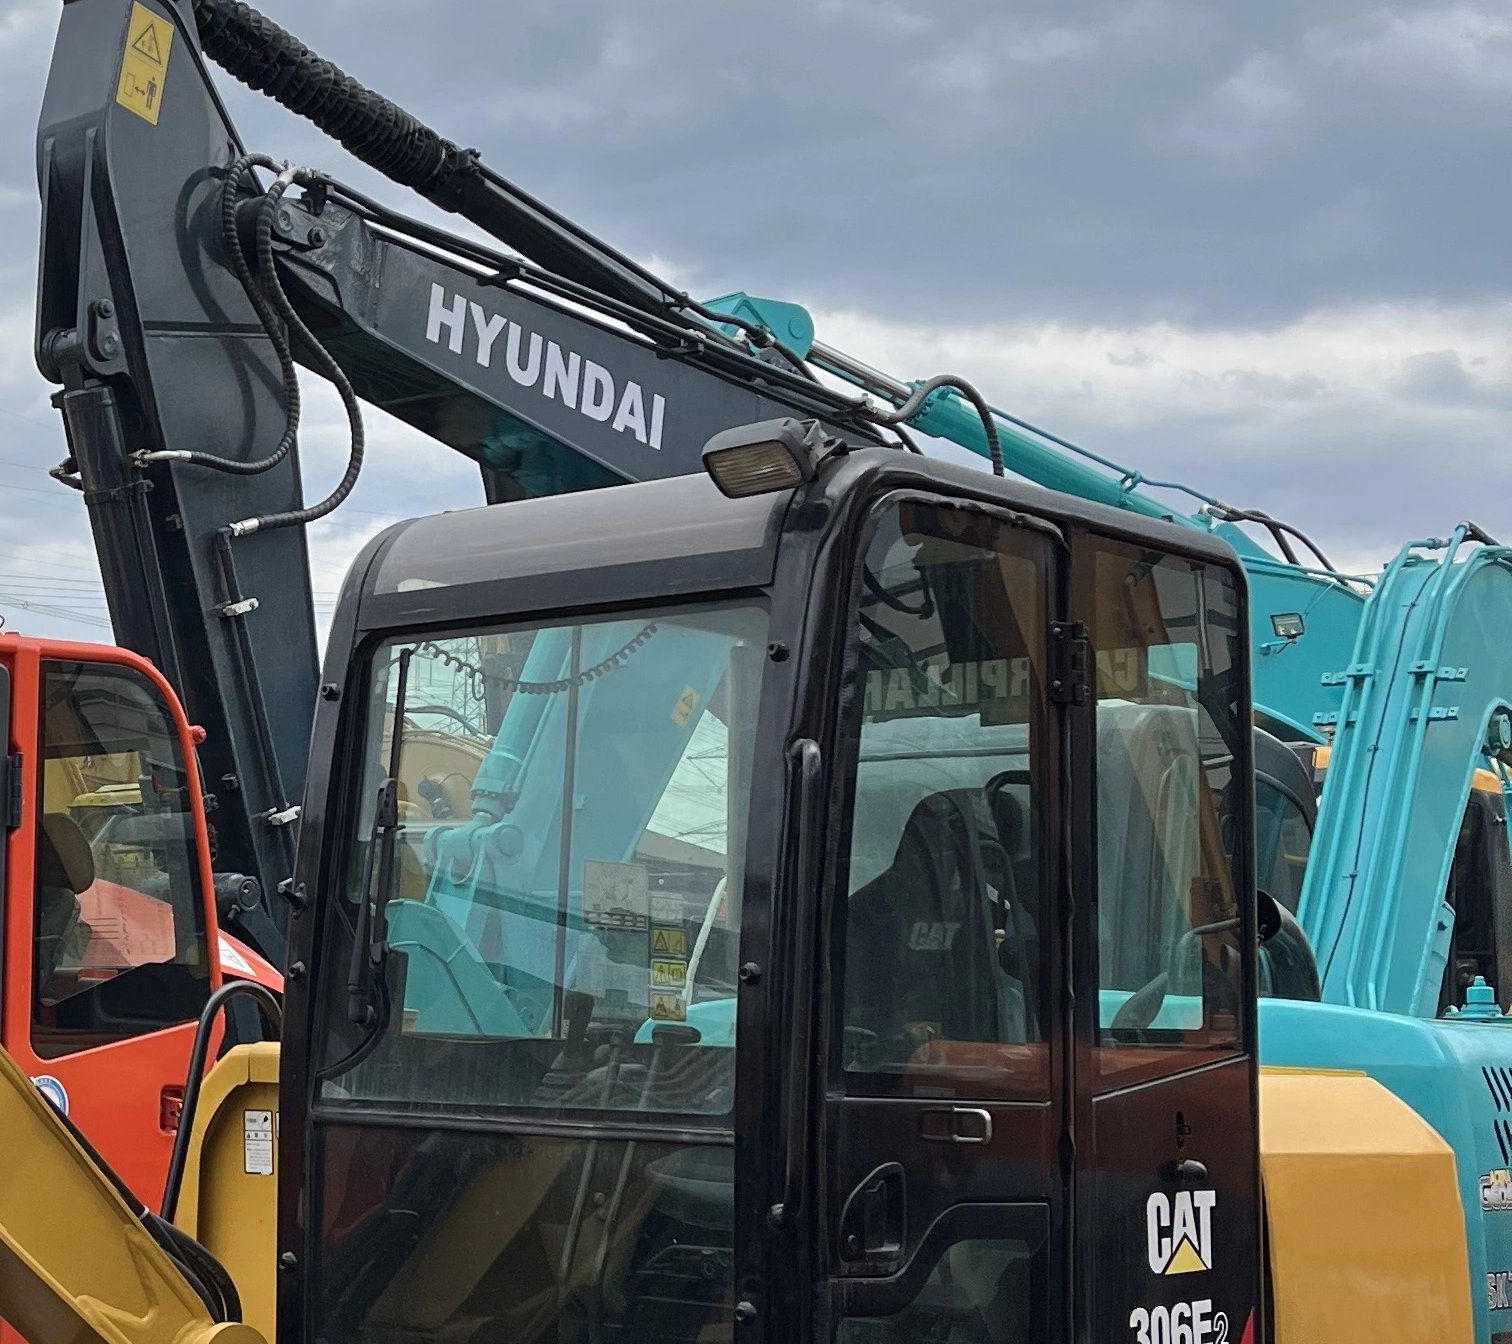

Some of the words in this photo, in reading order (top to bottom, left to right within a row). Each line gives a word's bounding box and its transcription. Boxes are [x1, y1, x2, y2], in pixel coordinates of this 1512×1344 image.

[425, 282, 666, 450] HYUNDAI
[908, 921, 961, 950] CAT
[1146, 1190, 1216, 1275] CAT
